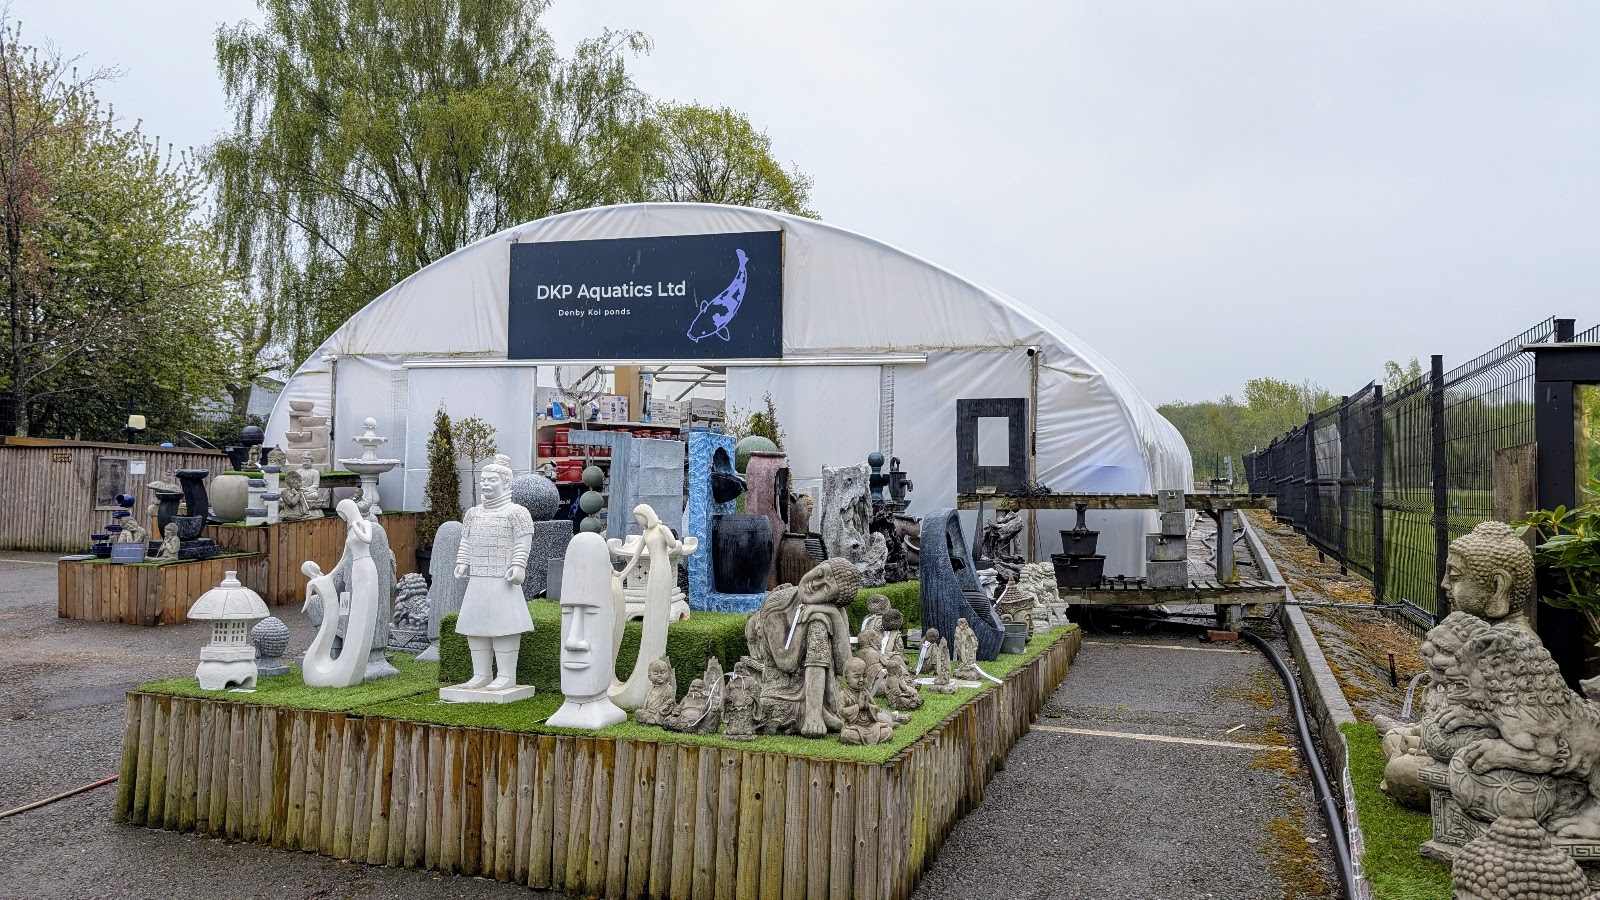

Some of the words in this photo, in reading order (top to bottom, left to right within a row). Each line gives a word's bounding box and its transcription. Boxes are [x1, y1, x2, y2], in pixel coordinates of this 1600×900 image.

[536, 284, 573, 300] DKP
[576, 281, 653, 302] Aquatics
[657, 280, 686, 297] Ltd
[558, 308, 585, 317] Denby
[588, 308, 601, 316] Koi
[604, 307, 631, 317] ponds
